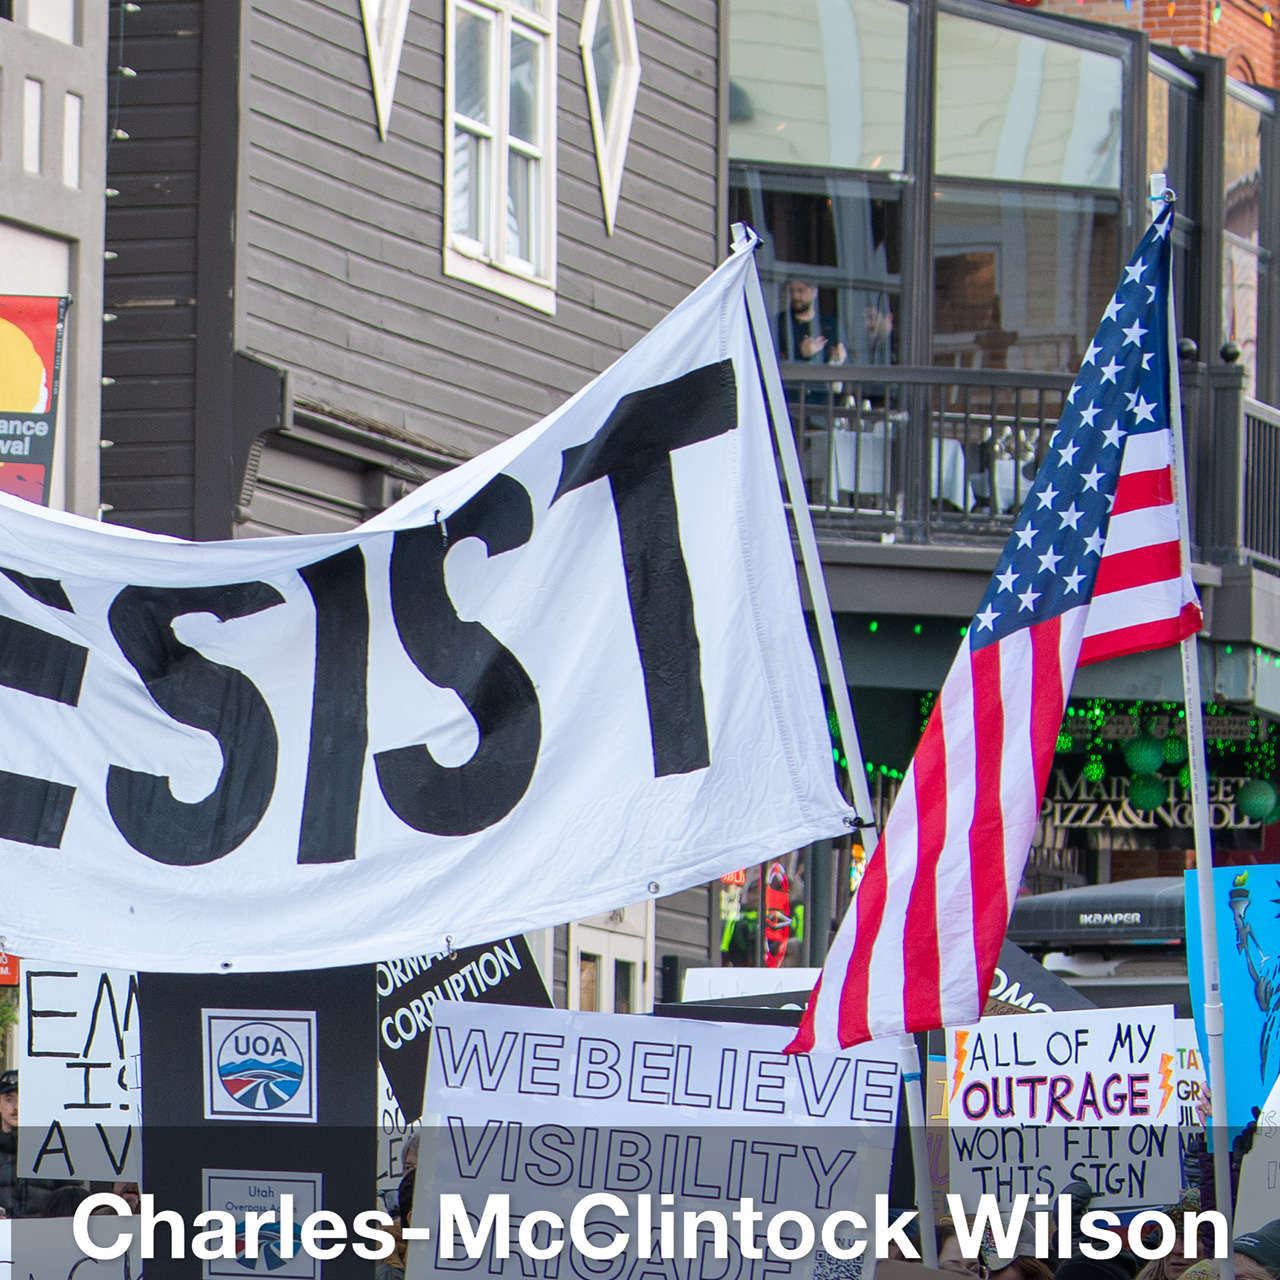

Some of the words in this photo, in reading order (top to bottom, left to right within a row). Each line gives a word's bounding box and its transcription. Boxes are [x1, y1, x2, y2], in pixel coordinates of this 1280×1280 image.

[234, 1035, 287, 1058] UOA
[969, 1032, 1037, 1071] ALL
[1046, 1029, 1090, 1066] OF
[1108, 1024, 1156, 1064] MY
[436, 1026, 564, 1095] WE
[573, 1037, 898, 1123] BELIEVE
[962, 1072, 1151, 1124] OUTRAGE
[446, 1116, 857, 1208] VISIBILITY
[1064, 1126, 1117, 1161] FIT
[1128, 1124, 1168, 1159] ON
[248, 1186, 275, 1198] Utah
[973, 1165, 1055, 1203] THIS
[1070, 1161, 1147, 1200] SIGN
